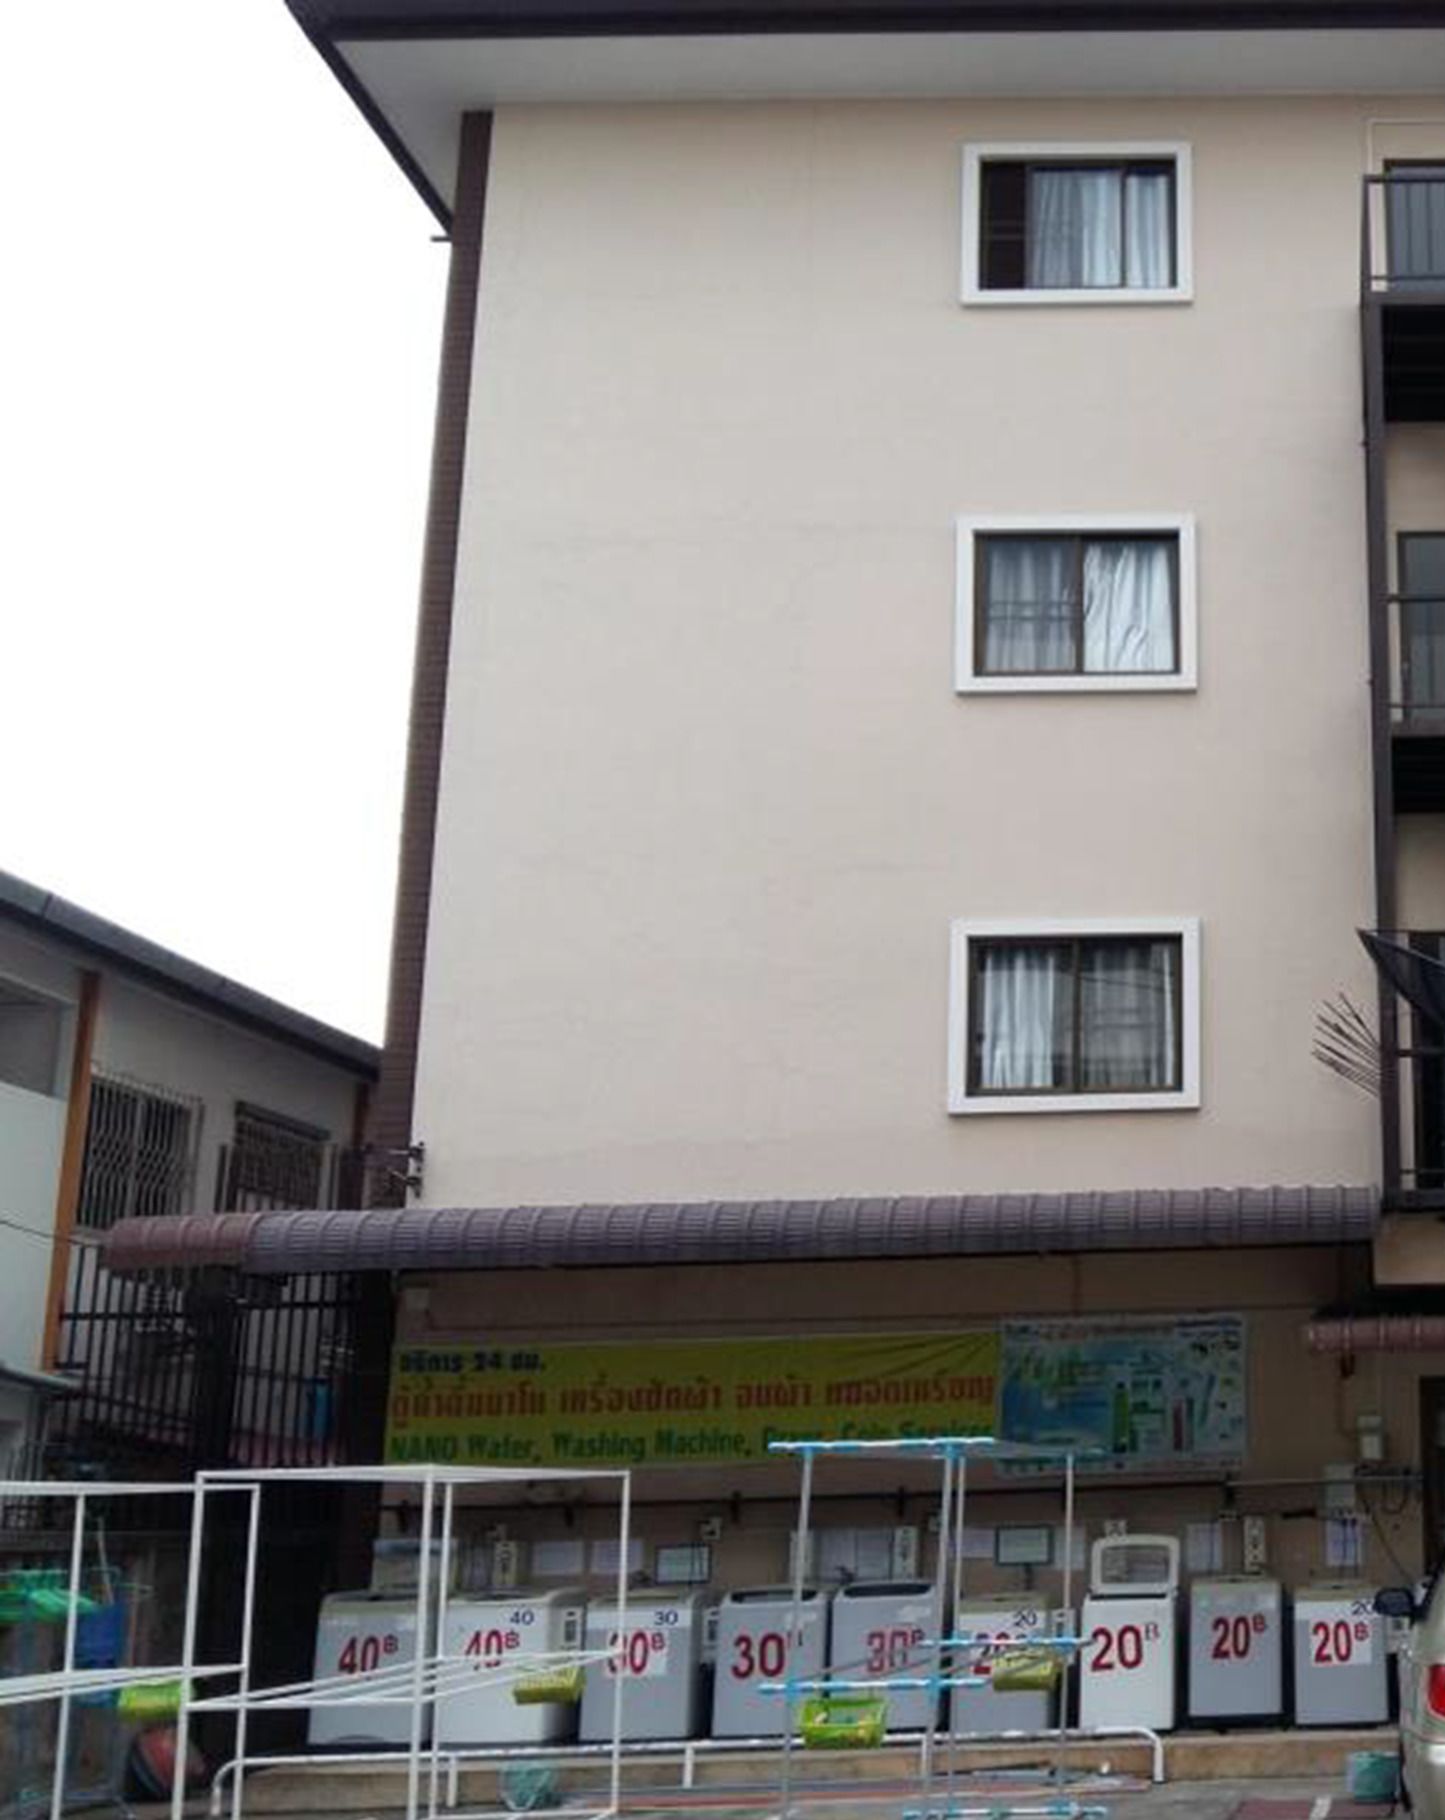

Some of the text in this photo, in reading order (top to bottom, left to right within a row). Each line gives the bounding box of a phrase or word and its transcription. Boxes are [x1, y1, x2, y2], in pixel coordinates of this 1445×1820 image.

[473, 1350, 501, 1372] 24
[391, 1435, 457, 1460] NANO
[510, 1609, 535, 1626] 40
[654, 1610, 679, 1626] 30
[1015, 1607, 1038, 1628] 20
